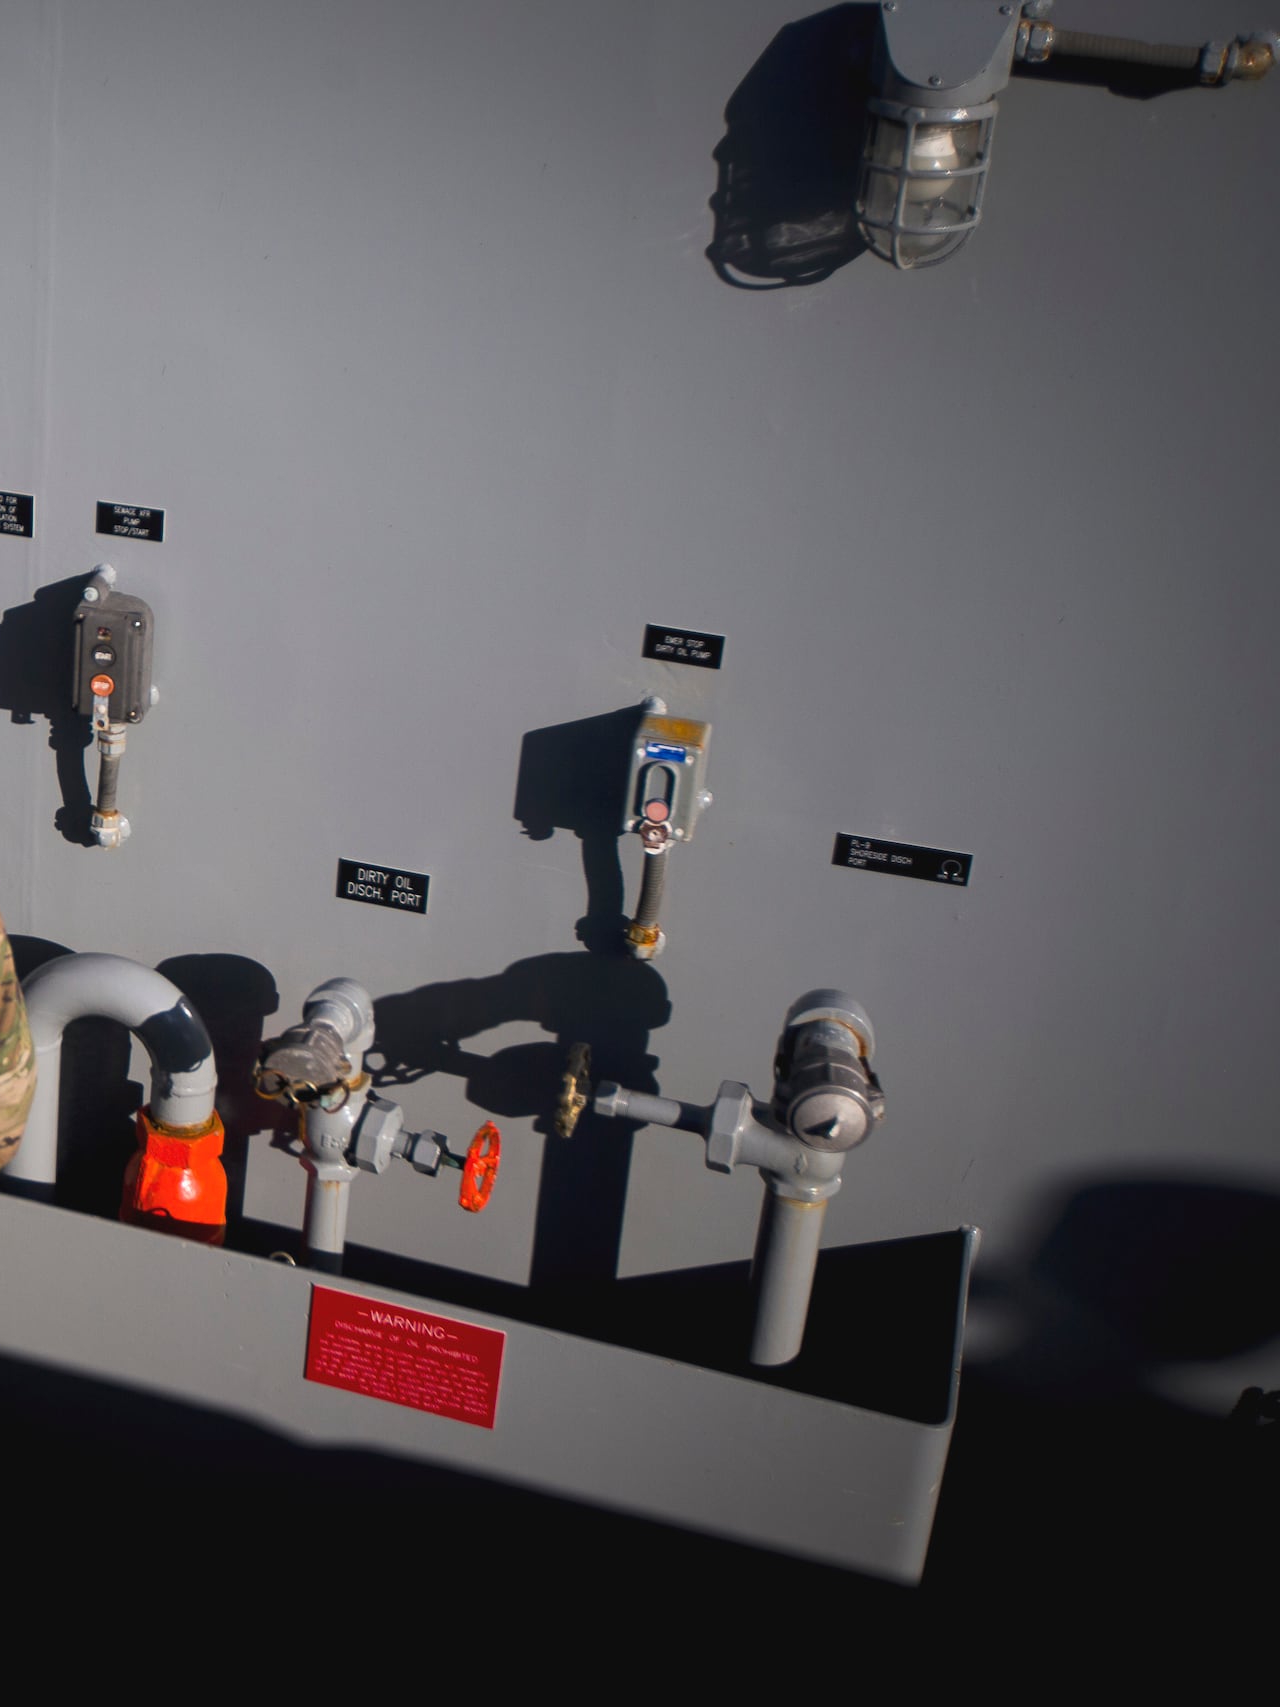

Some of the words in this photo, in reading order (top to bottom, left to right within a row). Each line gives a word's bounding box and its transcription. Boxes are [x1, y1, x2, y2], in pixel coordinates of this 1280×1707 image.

[6, 496, 18, 504] FOR
[123, 516, 140, 525] PUMP
[3, 522, 24, 532] SYSTEM
[114, 525, 149, 536] STOP/START
[686, 639, 705, 648] STOP
[690, 649, 712, 659] PUMP
[93, 681, 110, 690] STOP
[848, 857, 867, 866] PORT
[850, 848, 888, 861] SHORESIDE
[890, 854, 913, 865] DISCH
[357, 867, 389, 885] DIRTY
[395, 875, 414, 891] OIL
[347, 881, 384, 900] DISCH.
[391, 890, 422, 907] PORT
